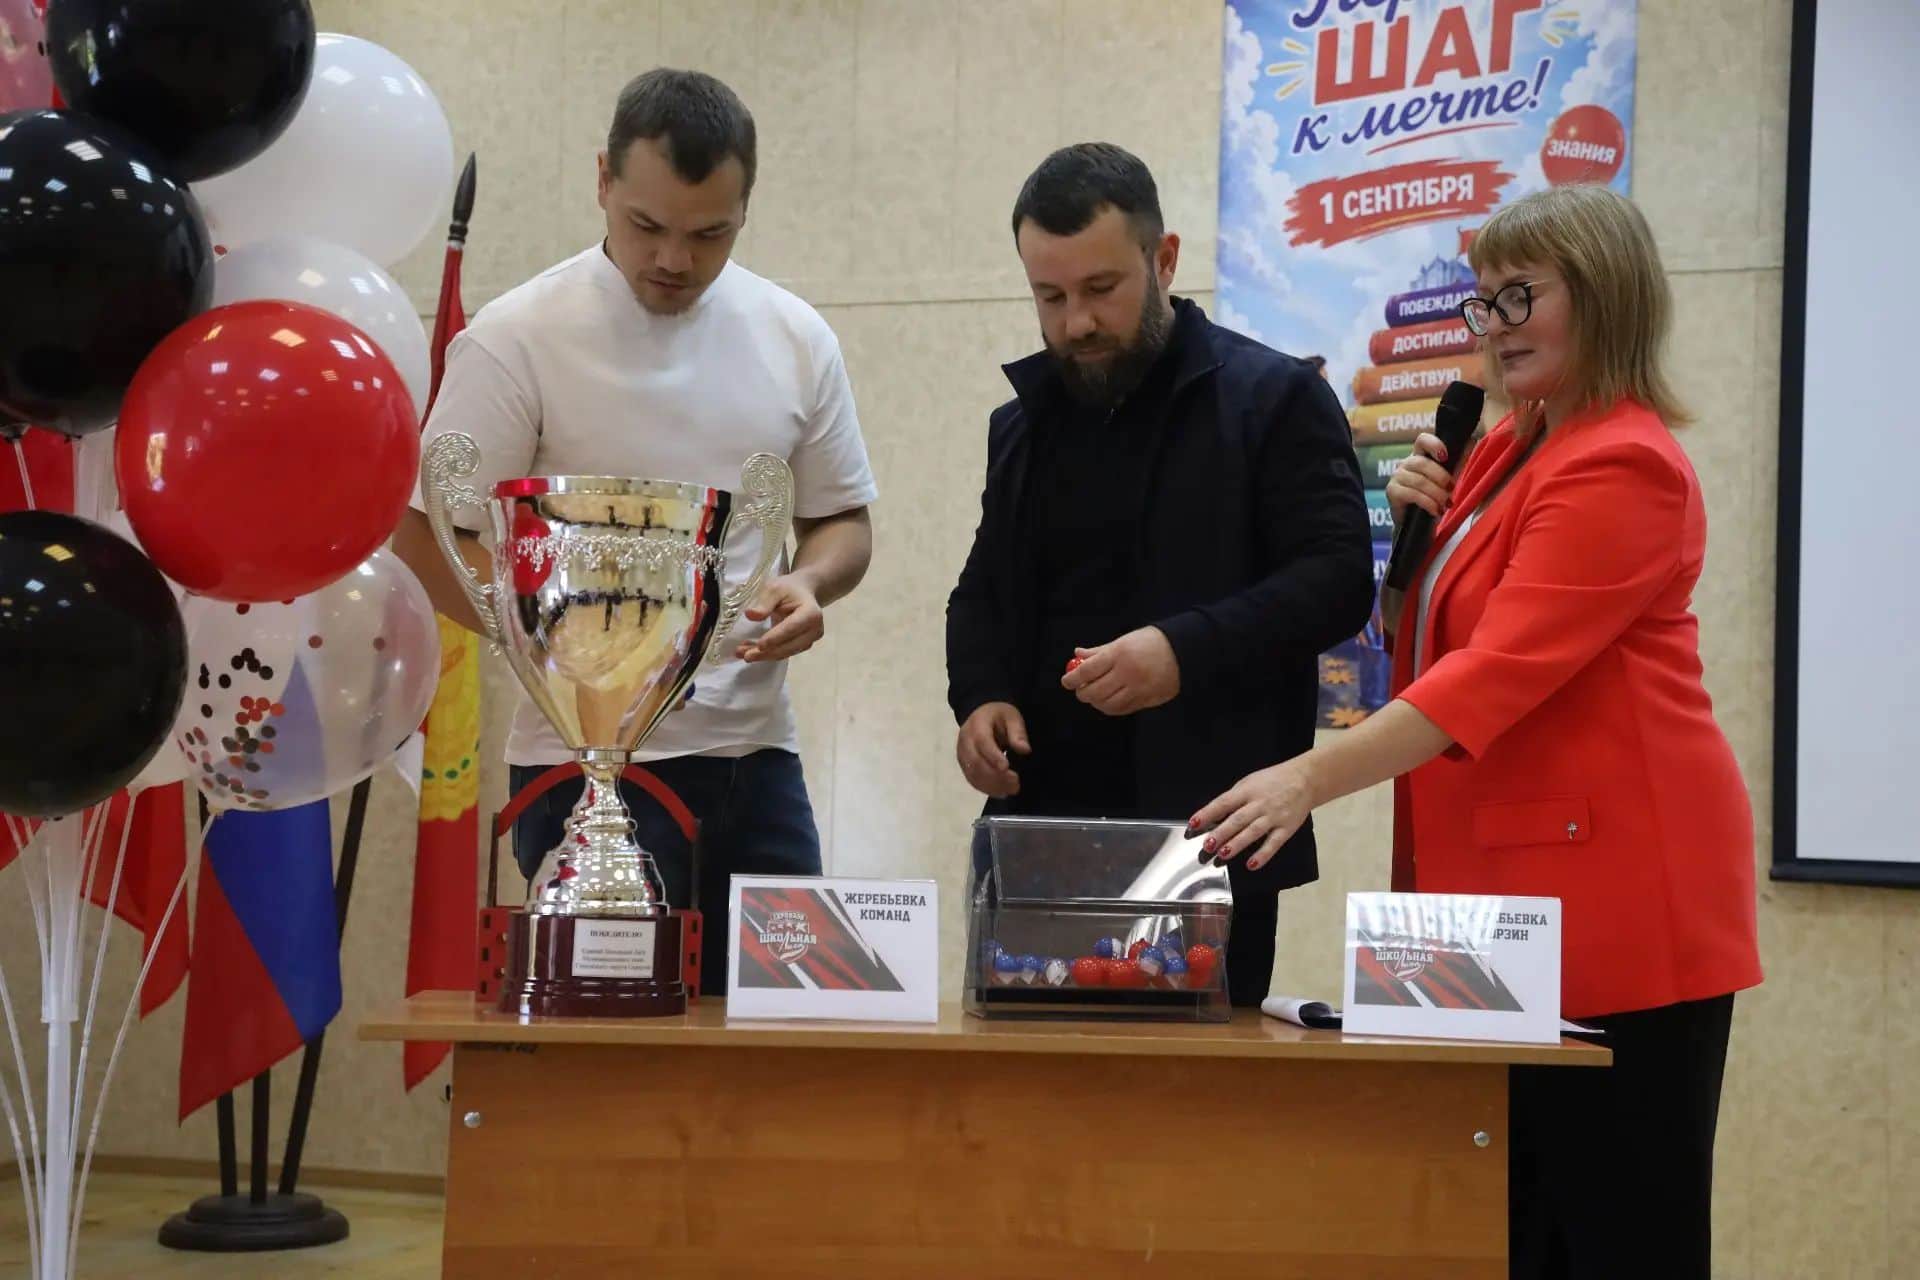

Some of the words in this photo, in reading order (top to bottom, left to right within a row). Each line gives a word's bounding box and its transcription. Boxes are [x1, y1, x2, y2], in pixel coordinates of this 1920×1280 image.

[1314, 0, 1542, 105] ШАГ
[1342, 59, 1550, 144] мечте!
[1547, 139, 1617, 165] знания
[1319, 191, 1334, 224] 1
[1343, 173, 1474, 219] СЕНТЯБРЯ
[1392, 327, 1469, 355] ДОСТИГАЮ
[1380, 367, 1461, 394] ДЕЙСТВУЮ
[1377, 412, 1436, 432] СТАРАЮ
[844, 892, 926, 906] ЖЕРЕБЬЕВКА
[860, 908, 911, 922] КОМАНД
[1497, 912, 1547, 926] БЬЕВКА
[1493, 928, 1529, 941] РЗИН
